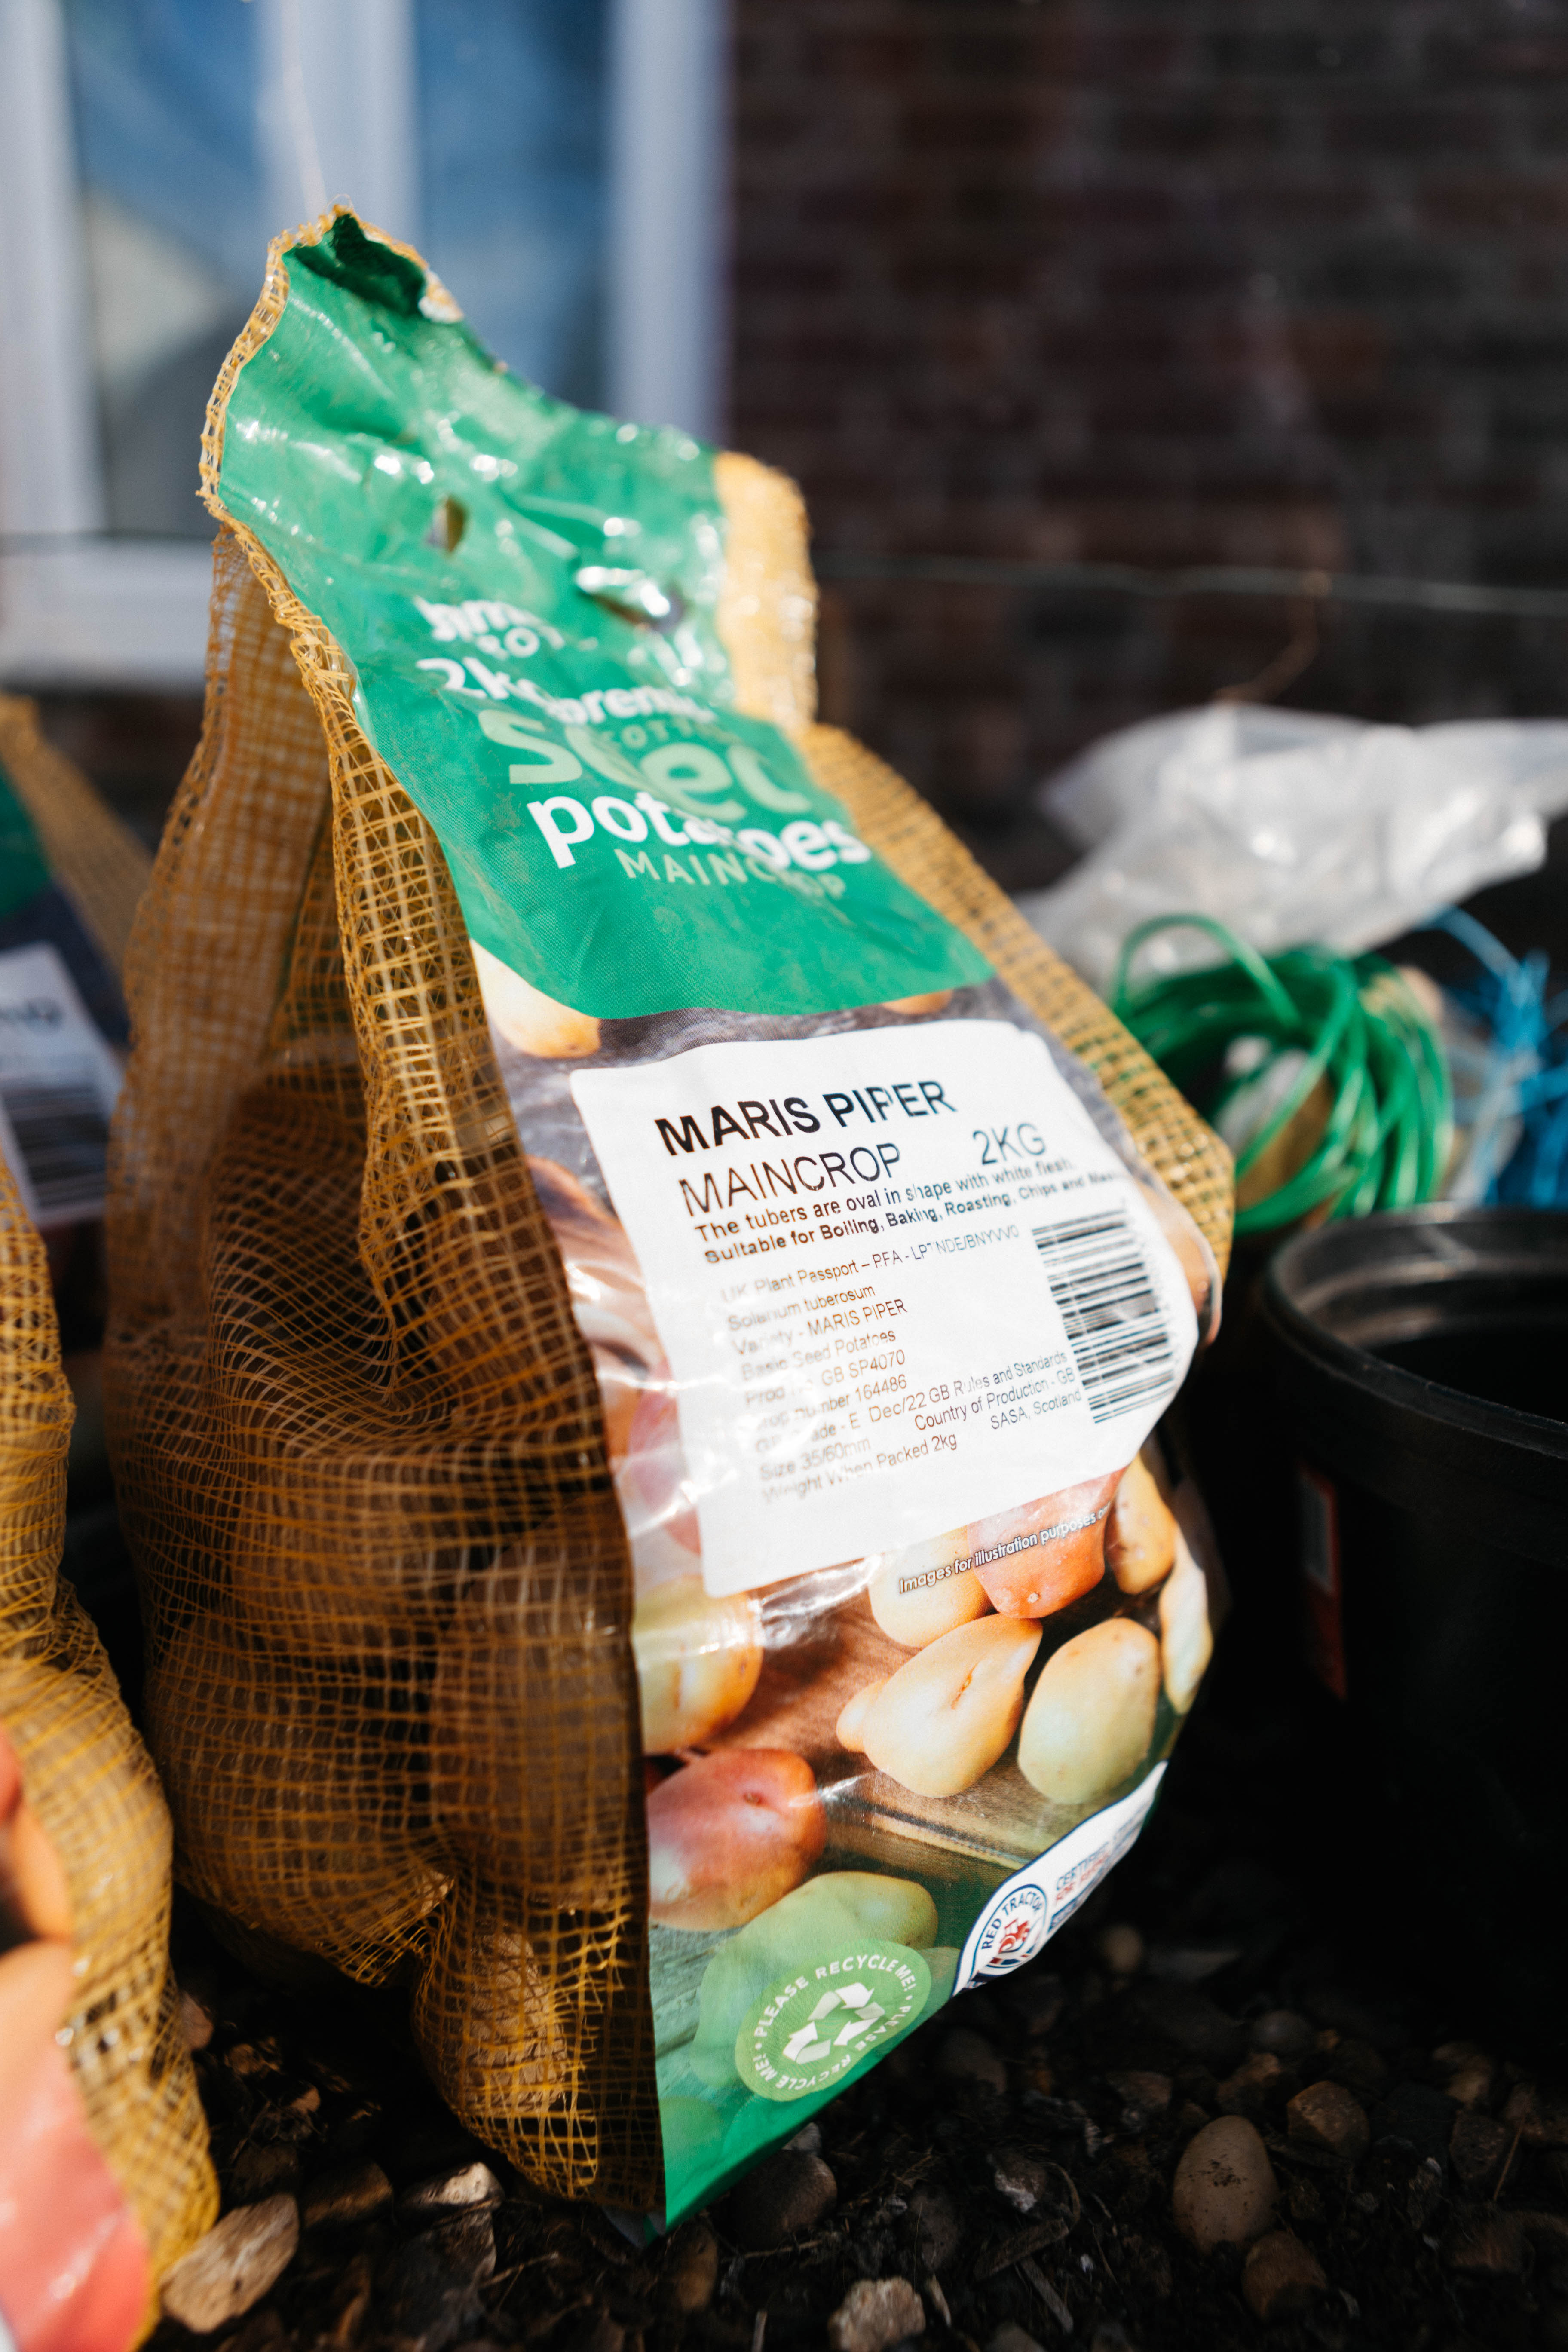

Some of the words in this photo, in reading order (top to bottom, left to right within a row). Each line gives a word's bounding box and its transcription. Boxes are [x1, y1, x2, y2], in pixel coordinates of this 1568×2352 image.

[526, 790, 873, 870] potoes
[613, 848, 847, 901] MAINCP
[655, 1097, 820, 1156] MARIS
[823, 1081, 958, 1129] PIPER
[679, 1143, 902, 1217] MAINCROP
[973, 1123, 1046, 1165] 2KG
[694, 1220, 740, 1243] The
[745, 1207, 808, 1230] tubers
[813, 1200, 842, 1219] are
[846, 1188, 882, 1212] oval
[884, 1187, 902, 1205] in
[906, 1179, 952, 1202] shape
[956, 1173, 989, 1192] with
[992, 1165, 1032, 1185] white
[704, 1232, 787, 1264] Suitable
[790, 1229, 816, 1246] for
[819, 1217, 885, 1241] Boiling,
[885, 1207, 943, 1228] Baking,
[1018, 1182, 1058, 1200] Chips
[1061, 1176, 1086, 1191] and
[754, 1274, 796, 1293] Plant
[797, 1259, 859, 1285] Passport
[872, 1250, 903, 1269] PFA
[803, 1285, 876, 1313] tuberosum
[731, 1330, 793, 1356] Vaty
[807, 1309, 861, 1337] MARIS
[862, 1298, 908, 1322] PIPER
[792, 1343, 832, 1369] Seed
[835, 1329, 896, 1356] Potatoes
[821, 1366, 845, 1387] GB
[848, 1349, 906, 1379] SP4070
[848, 1412, 861, 1430] E
[868, 1392, 928, 1423] Dec/22
[929, 1383, 950, 1404] GB
[993, 1367, 1013, 1386] and
[1014, 1350, 1068, 1378] Standards
[855, 1374, 907, 1403] 164486
[914, 1405, 968, 1431] Country
[971, 1396, 983, 1414] of
[986, 1375, 1050, 1409] Production
[1056, 1366, 1077, 1386] GB
[990, 1405, 1032, 1430] SASA,
[1033, 1389, 1083, 1415] Scotland
[876, 1439, 929, 1470] Packed
[931, 1432, 957, 1452] 2kg
[899, 1564, 952, 1595] Images
[953, 1556, 973, 1575] for
[974, 1531, 1038, 1567] illustration
[1039, 1511, 1097, 1547] purposes
[981, 1917, 1002, 1951] RED
[754, 1975, 809, 2038] PLEASE
[815, 1954, 899, 1980] RECYCLE
[894, 1963, 917, 1993] ME!
[854, 2005, 912, 2051] PLEASE
[752, 2052, 778, 2082] ME!
[775, 2054, 852, 2091] RECYCLE
